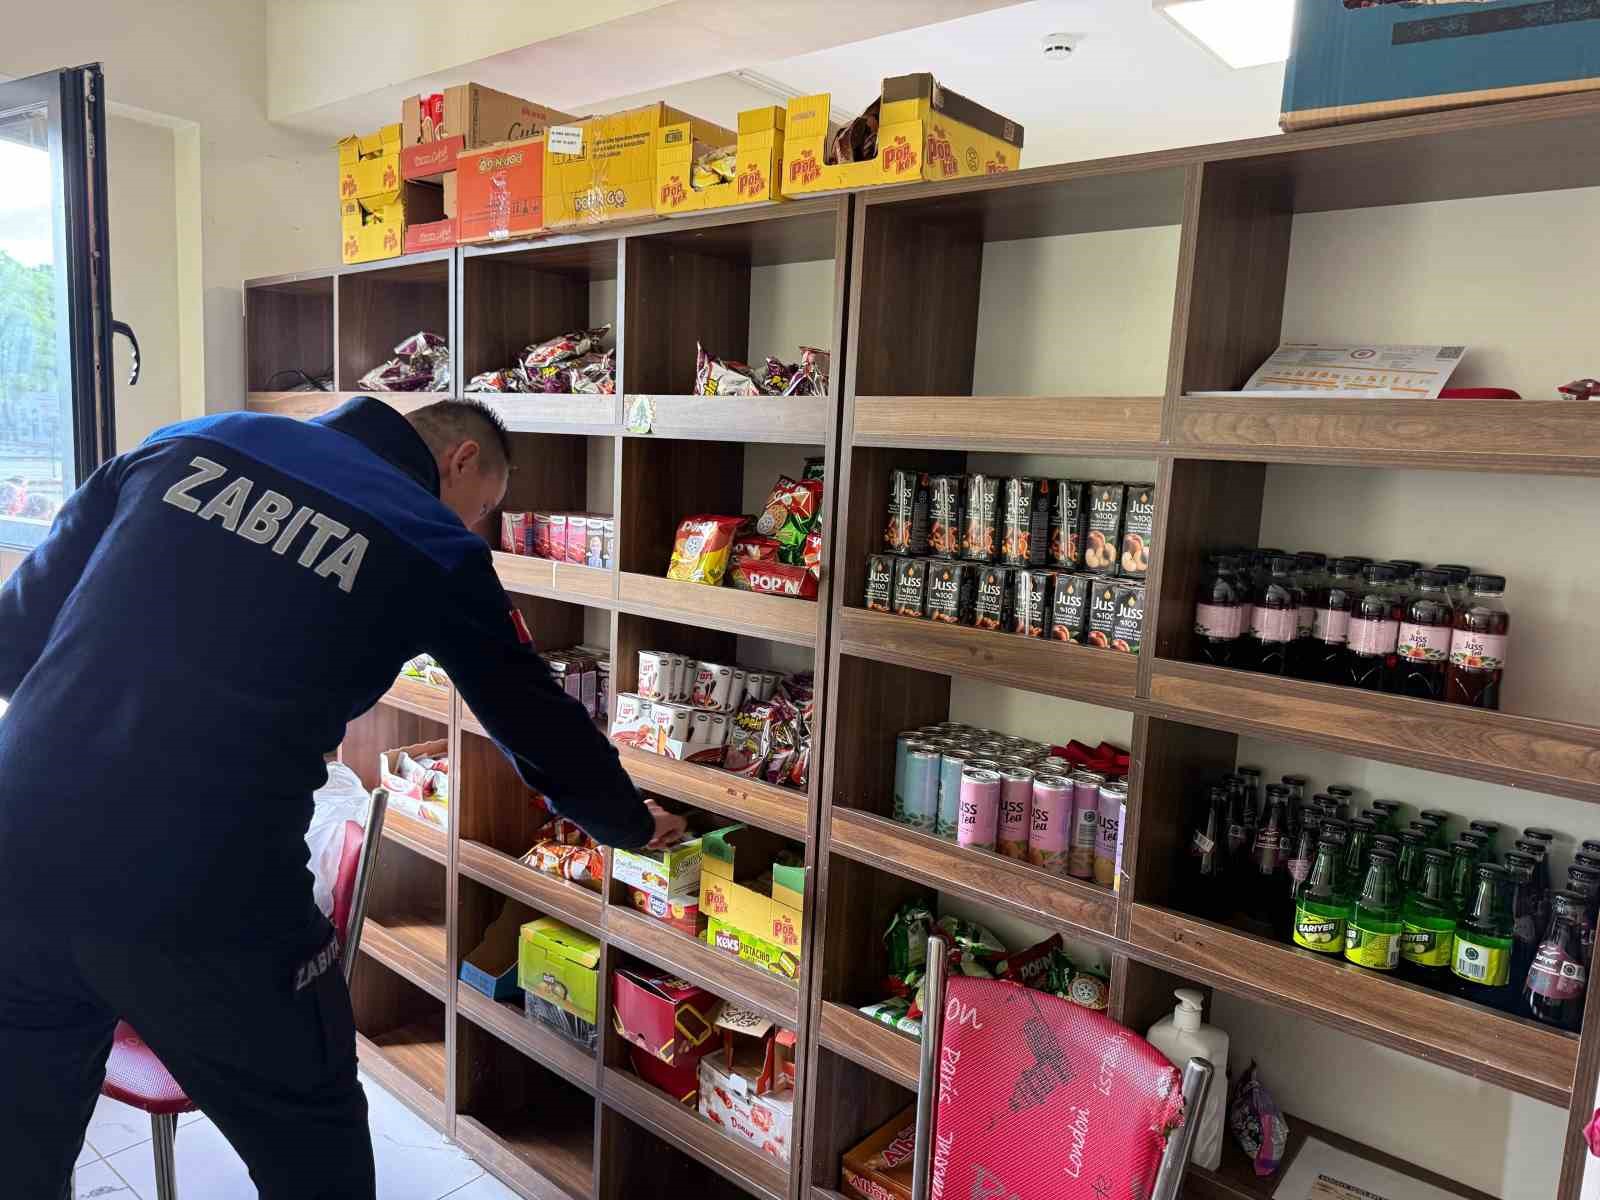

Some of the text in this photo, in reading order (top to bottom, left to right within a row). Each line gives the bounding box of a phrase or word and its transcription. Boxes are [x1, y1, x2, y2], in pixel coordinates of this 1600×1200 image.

[1092, 497, 1118, 512] Juss
[162, 455, 370, 593] ZABITA
[869, 569, 890, 583] Juss
[898, 573, 922, 588] Juss
[932, 577, 959, 592] Juss
[978, 581, 1001, 596] Juss
[1056, 591, 1082, 608] Juss
[1093, 596, 1116, 612] Jus
[1117, 602, 1144, 620] Juss
[1062, 1105, 1091, 1178] London
